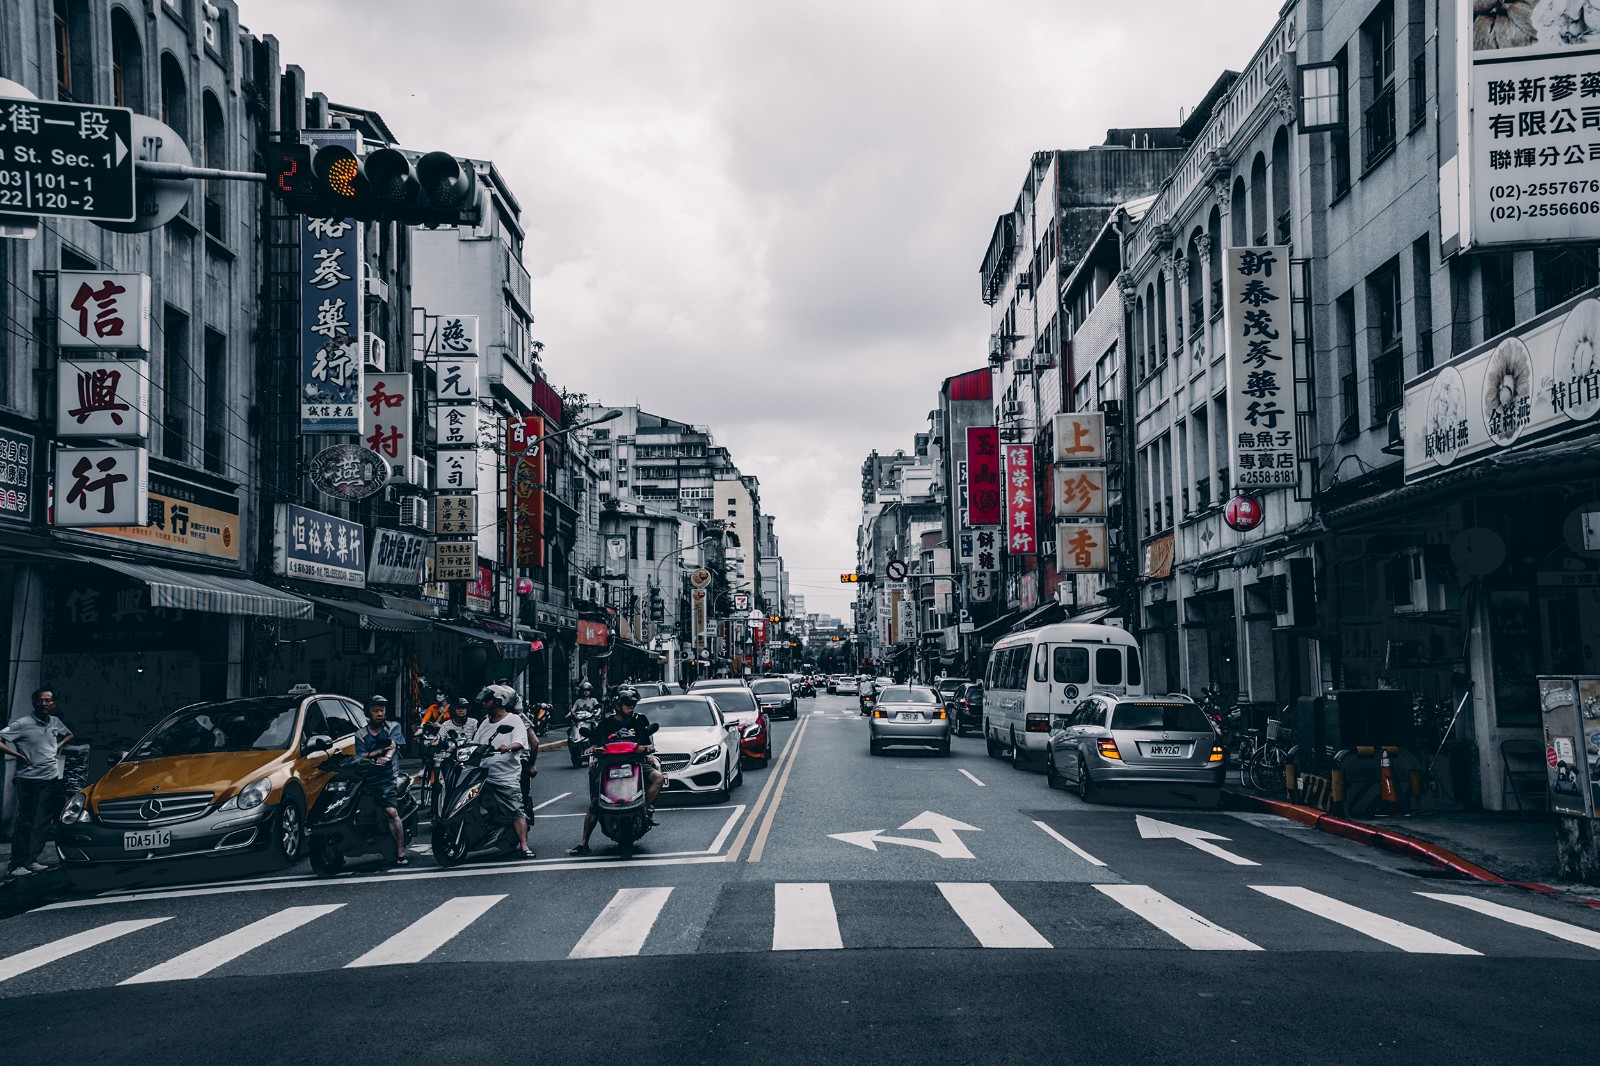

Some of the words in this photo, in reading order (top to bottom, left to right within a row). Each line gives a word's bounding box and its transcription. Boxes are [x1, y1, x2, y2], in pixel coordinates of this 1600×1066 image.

[1488, 71, 1600, 105] 聯新蔘藥
[1489, 106, 1600, 139] 有限公司
[14, 146, 41, 163] St.
[51, 149, 95, 168] Sec.
[103, 153, 111, 169] 1
[1490, 180, 1599, 202] (02)-2557676
[1490, 201, 1599, 222] (02)-2556606
[67, 280, 129, 513] 信興行
[308, 406, 353, 417] 誠信老店
[366, 382, 404, 458] 和村
[1488, 396, 1530, 436] 金絲燕
[1238, 431, 1292, 448] 烏魚子
[1239, 452, 1293, 469] 專賣店
[1247, 470, 1294, 483] 2558-8181
[1063, 422, 1100, 567] 上珍香
[959, 609, 968, 623] P
